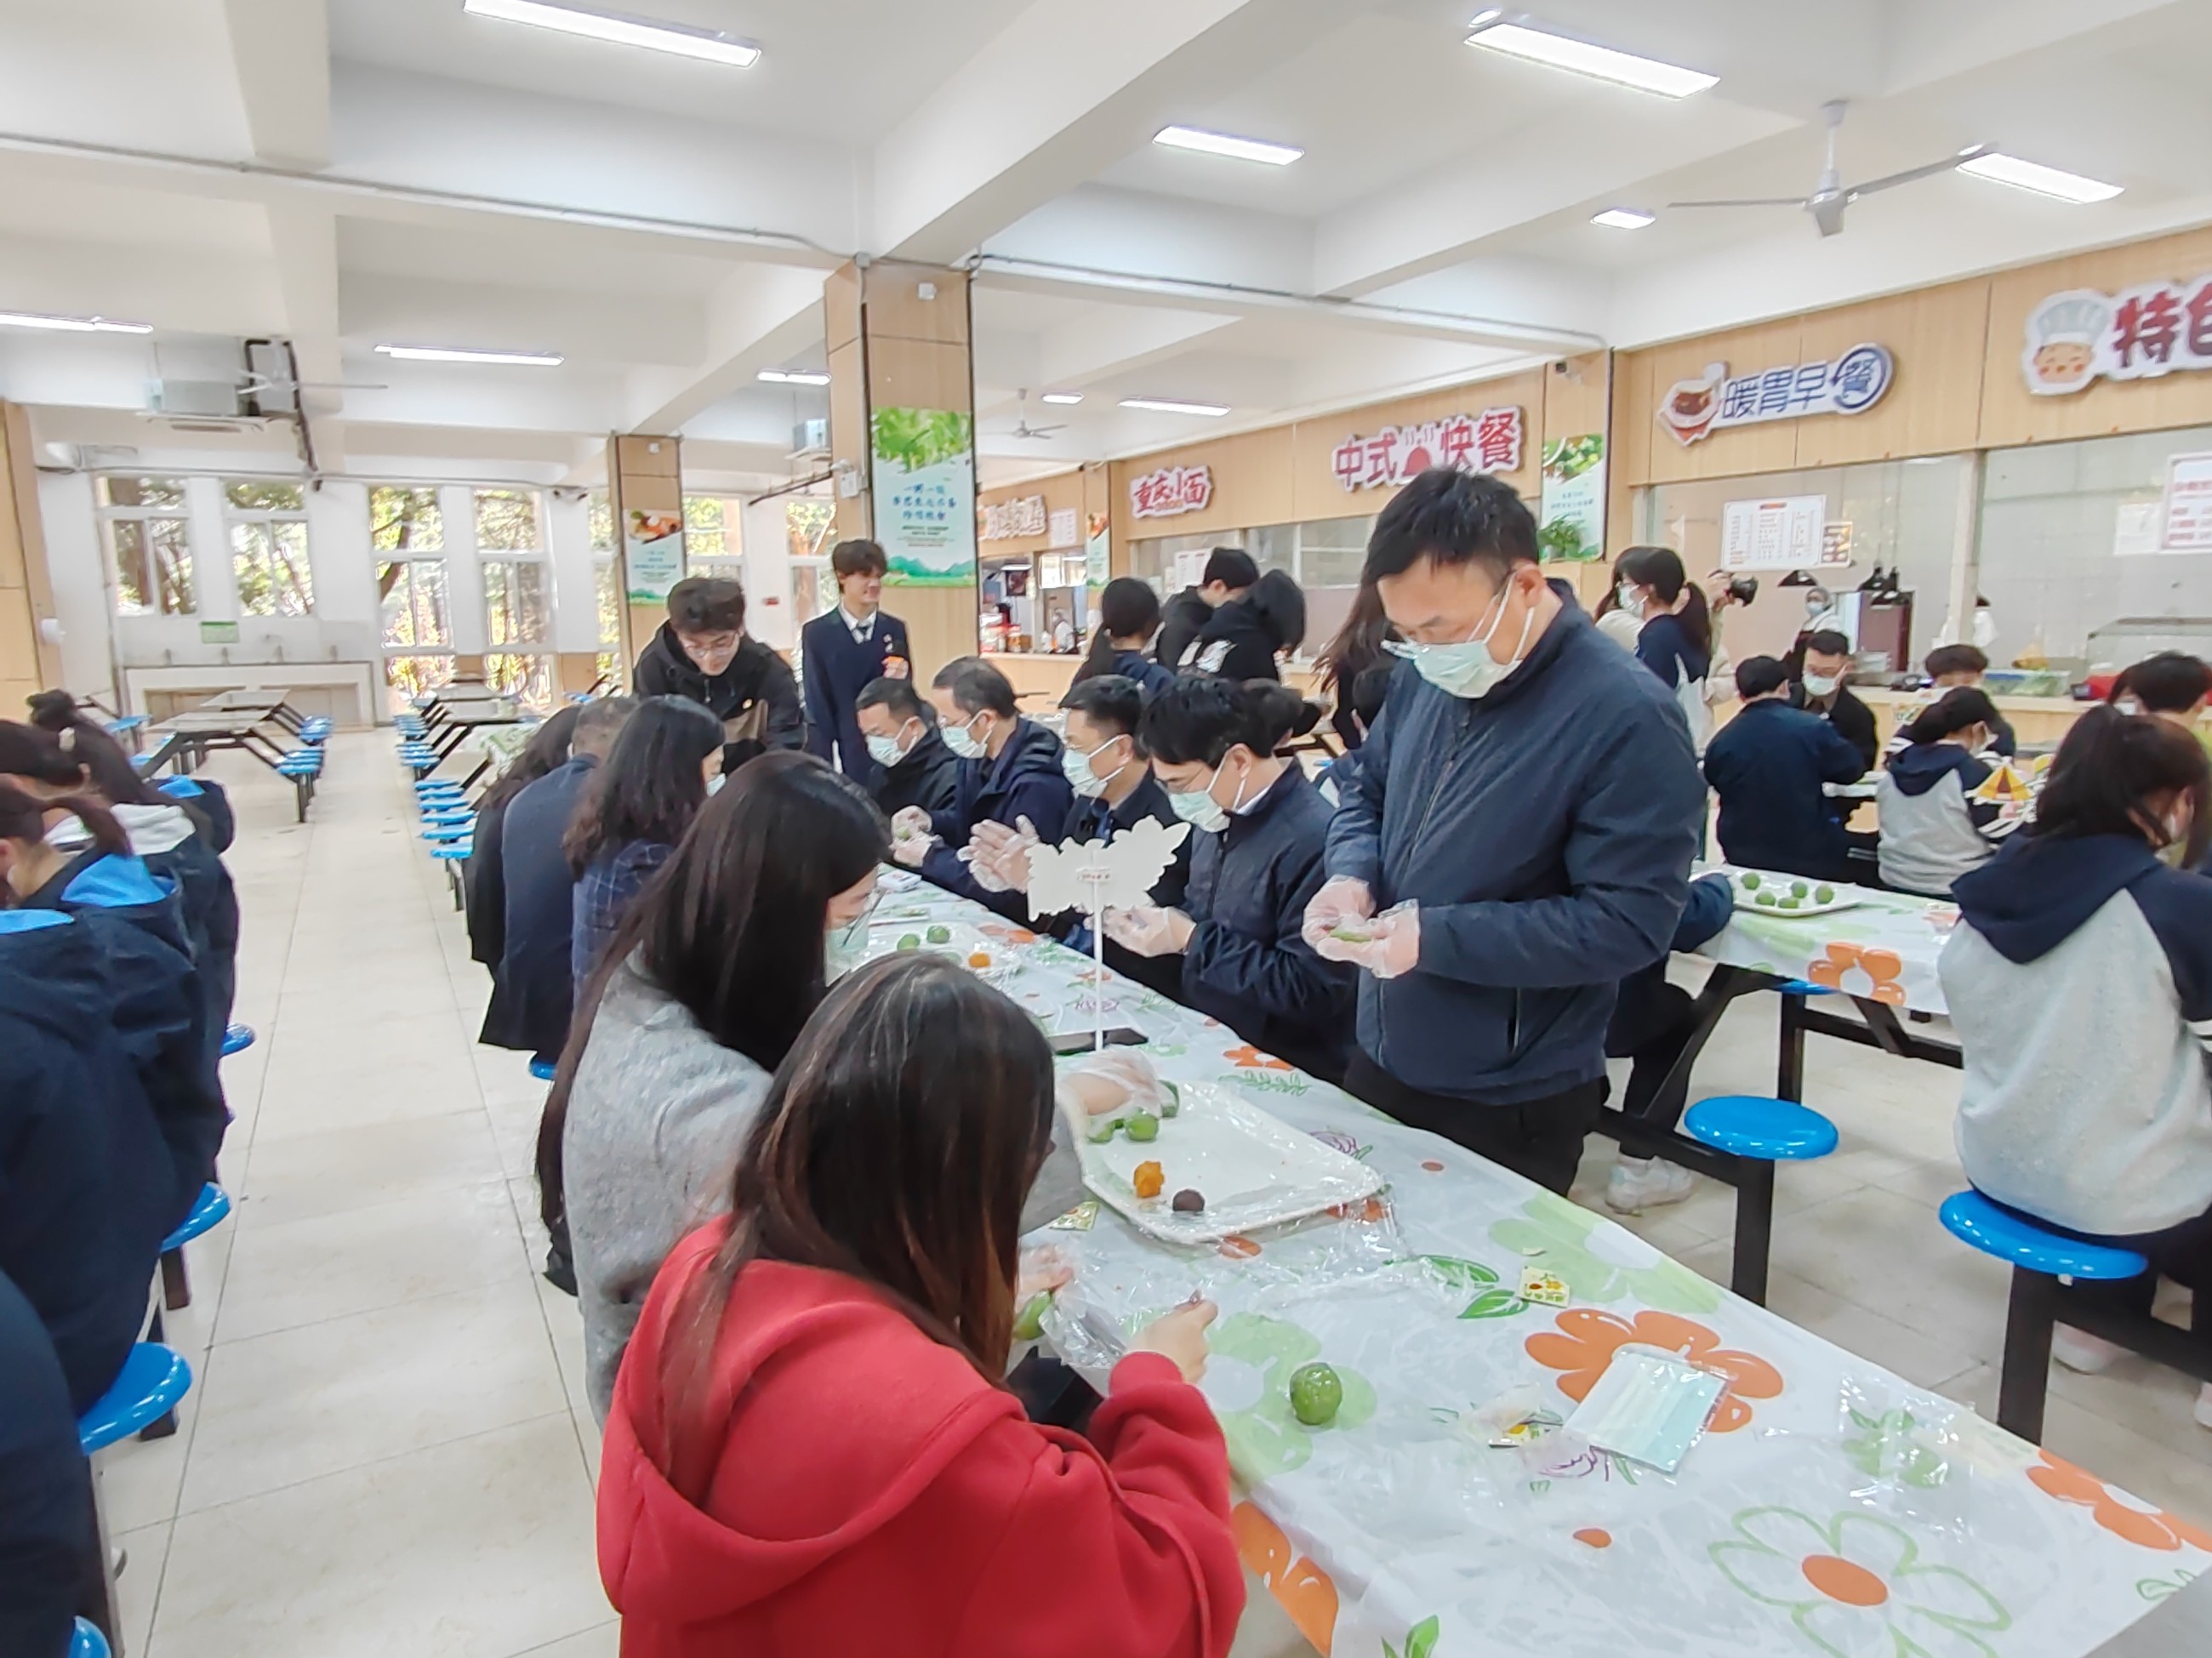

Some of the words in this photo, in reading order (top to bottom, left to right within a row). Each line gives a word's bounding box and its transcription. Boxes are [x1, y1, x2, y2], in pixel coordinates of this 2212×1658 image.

[1722, 351, 1880, 419] 暖胃早餐
[1133, 471, 1206, 514] 重庆小面
